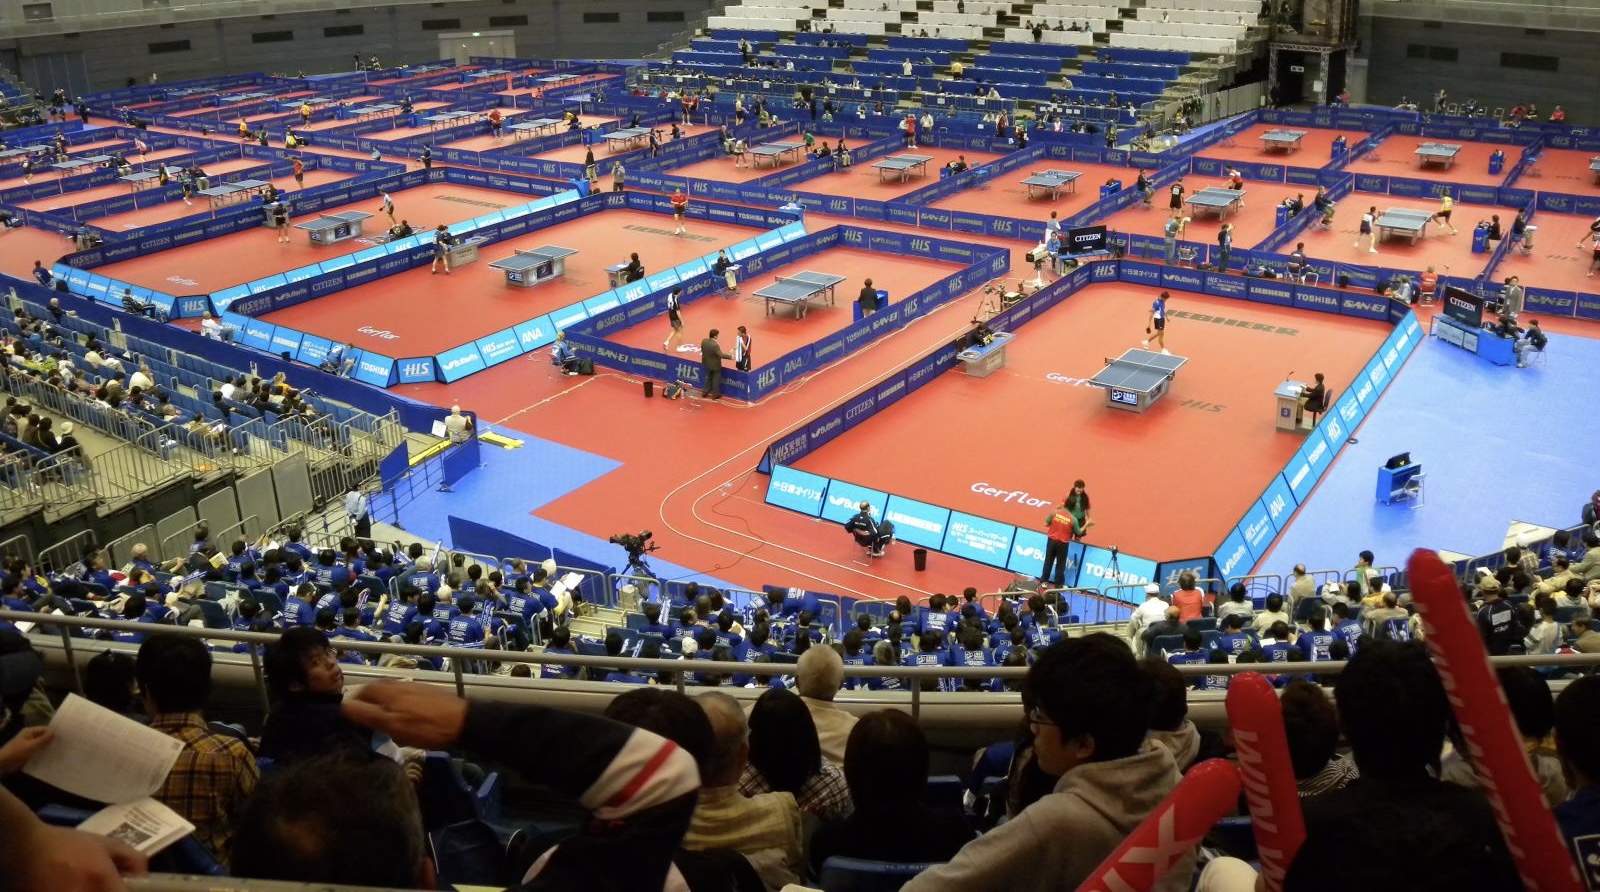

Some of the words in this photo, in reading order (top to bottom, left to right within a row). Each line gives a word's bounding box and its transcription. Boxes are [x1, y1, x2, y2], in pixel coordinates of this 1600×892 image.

[429, 170, 445, 180] HIS
[1260, 166, 1278, 177] HIS
[693, 181, 708, 192] HIS
[608, 195, 625, 205] HIS
[741, 190, 766, 199] TOSHIBA
[831, 200, 848, 210] HIS
[738, 212, 765, 222] TOSHIBA
[889, 208, 916, 218] TOSHIBA
[992, 219, 1012, 231] HIS
[141, 237, 171, 249] CITIZEN
[844, 230, 863, 242] HIS
[1075, 233, 1102, 243] CITIZEN
[910, 239, 930, 252] HIS
[747, 257, 763, 274] HIS
[992, 255, 1005, 270] HIS
[1095, 264, 1116, 277] HIS
[312, 277, 343, 292] CITIZEN
[949, 275, 962, 291] HIS
[625, 286, 644, 303] HIS
[1250, 286, 1291, 298] LIEBHERR
[1296, 292, 1338, 306] TOSHIBA
[183, 300, 205, 312] HIS
[904, 299, 918, 315] HIS
[1343, 300, 1386, 313] SAN-EI
[1450, 296, 1476, 312] CITIZEN
[1168, 309, 1300, 337] IEBHERR
[357, 325, 401, 340] Gerflor
[522, 327, 543, 344] ANA
[596, 347, 628, 364] SAN-EI
[361, 361, 388, 377] TOSHIBA
[403, 362, 430, 377] HIS
[676, 363, 700, 382] HIS
[784, 356, 802, 374] ANA
[757, 367, 776, 389] HIS
[846, 397, 875, 420] CITIZEN
[1179, 398, 1226, 413] HIS
[1328, 417, 1342, 442] HIS
[774, 443, 789, 459] HIS
[971, 482, 1053, 509] Gerflor
[1270, 494, 1286, 519] ANA
[1086, 562, 1148, 585] TOSHIBA
